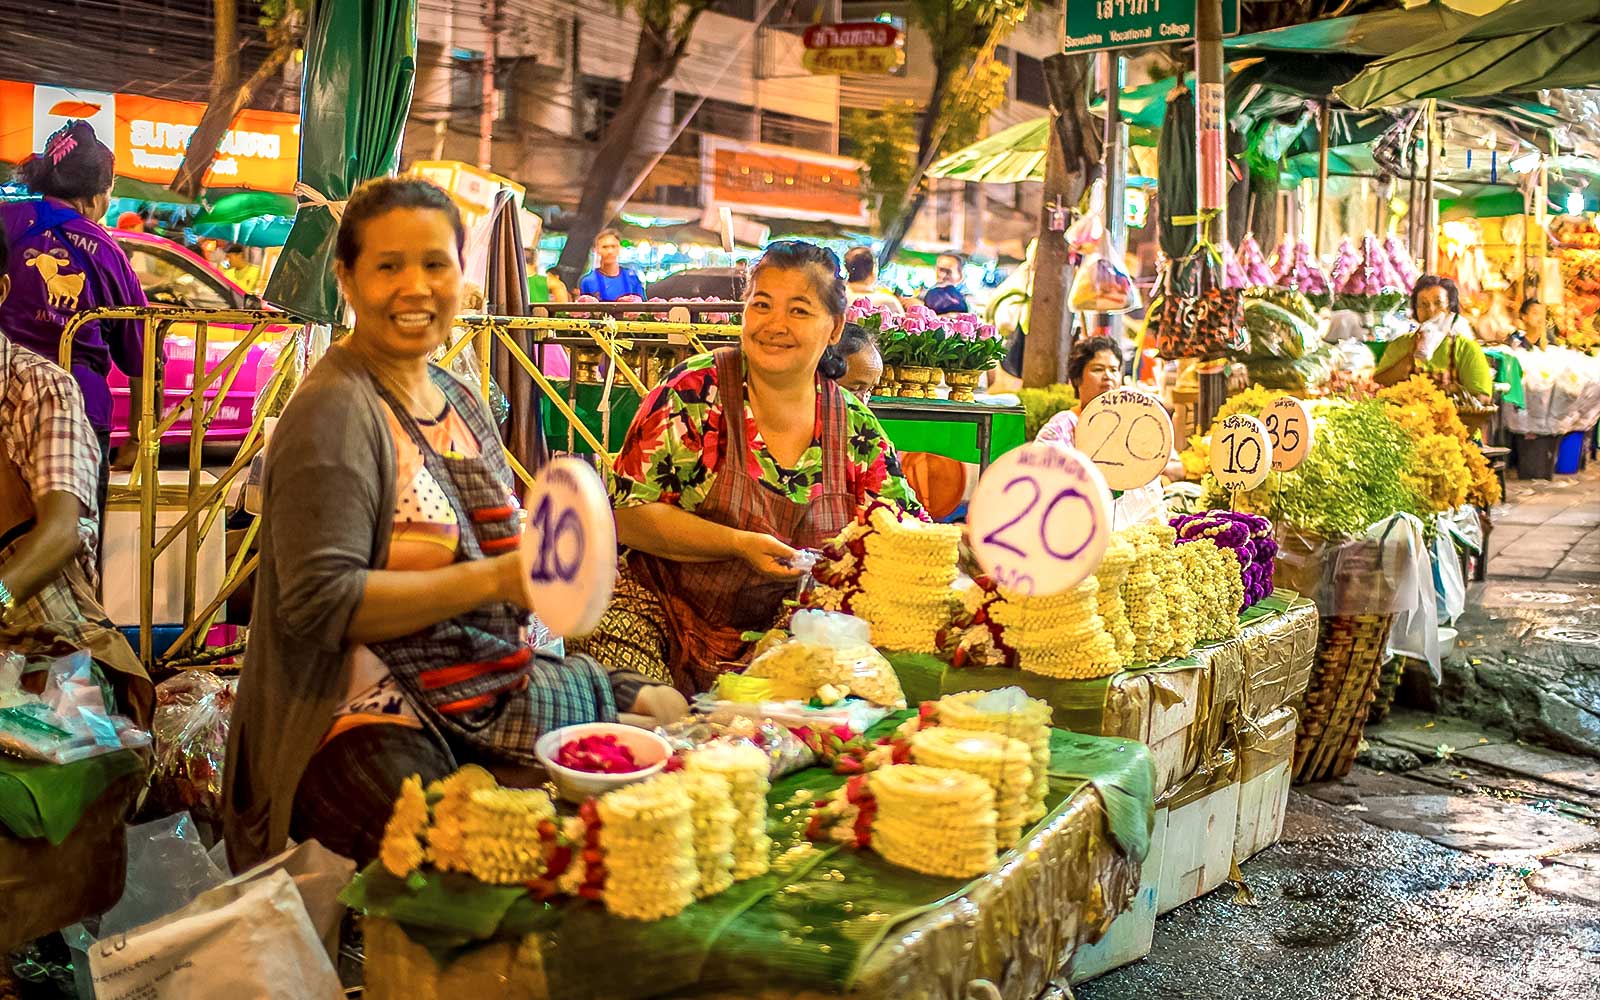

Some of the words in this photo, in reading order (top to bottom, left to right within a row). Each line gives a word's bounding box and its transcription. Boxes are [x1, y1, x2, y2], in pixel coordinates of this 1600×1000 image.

[1109, 26, 1152, 42] Vocational
[1159, 23, 1190, 37] College
[1088, 408, 1166, 468] 20
[1221, 432, 1261, 475] 10
[1265, 413, 1300, 453] 35
[531, 493, 585, 584] 10
[983, 475, 1097, 561] 20
